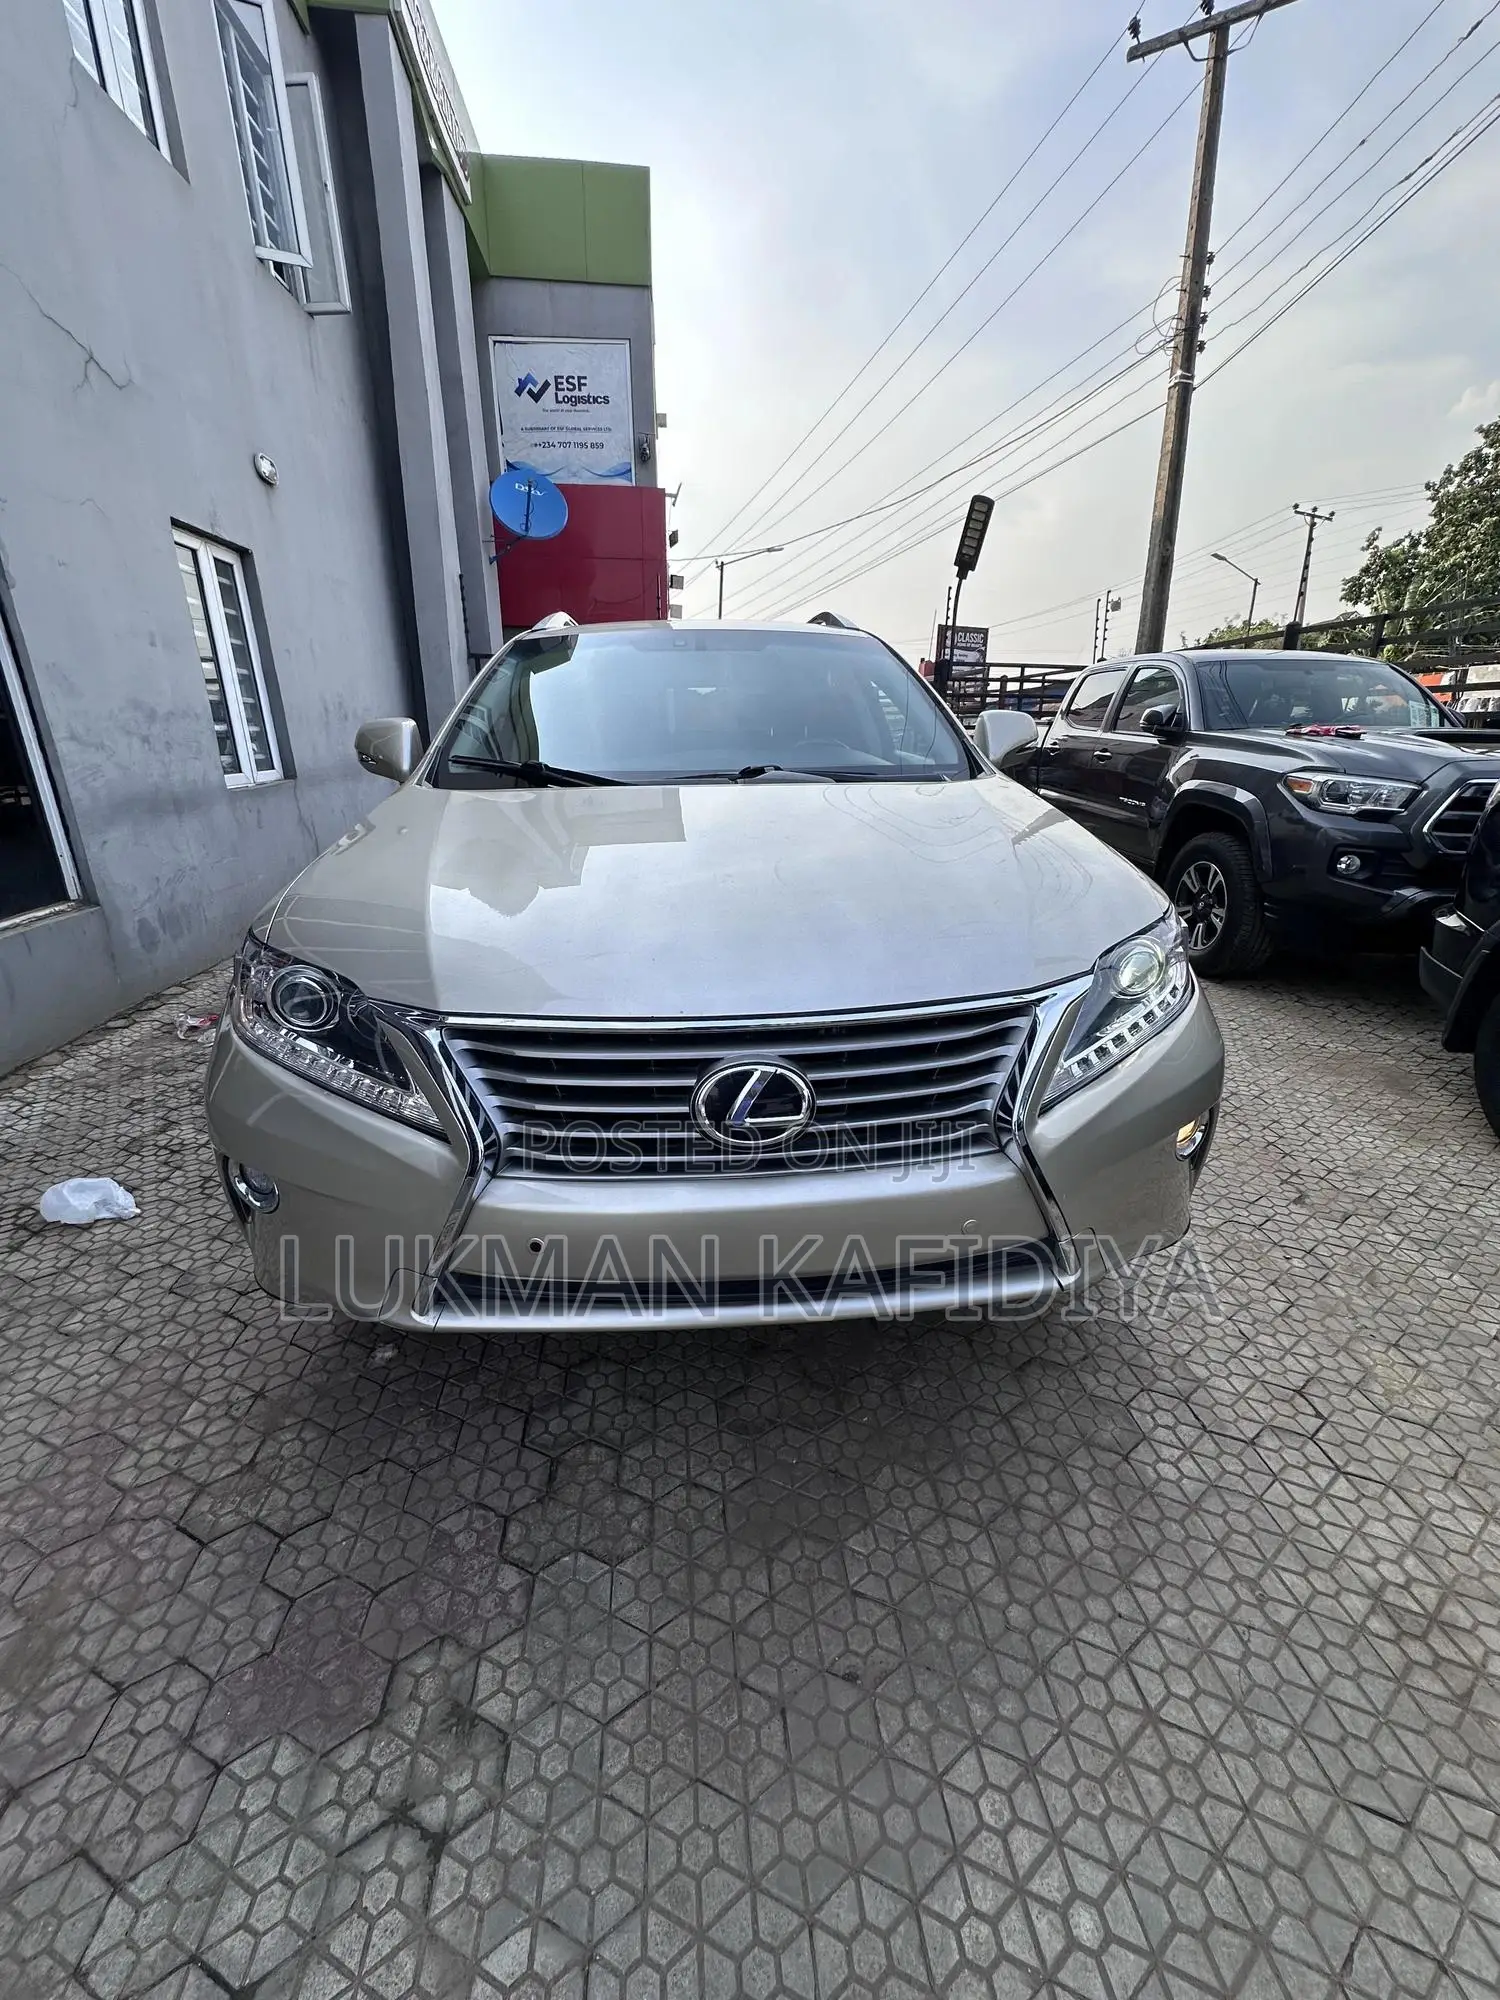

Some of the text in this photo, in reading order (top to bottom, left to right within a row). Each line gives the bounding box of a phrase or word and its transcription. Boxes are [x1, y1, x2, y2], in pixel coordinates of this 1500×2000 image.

[554, 375, 588, 392] ESF
[554, 392, 610, 407] Logistics
[557, 441, 572, 449] 707
[590, 442, 604, 450] 859
[957, 632, 984, 643] CLASSIC
